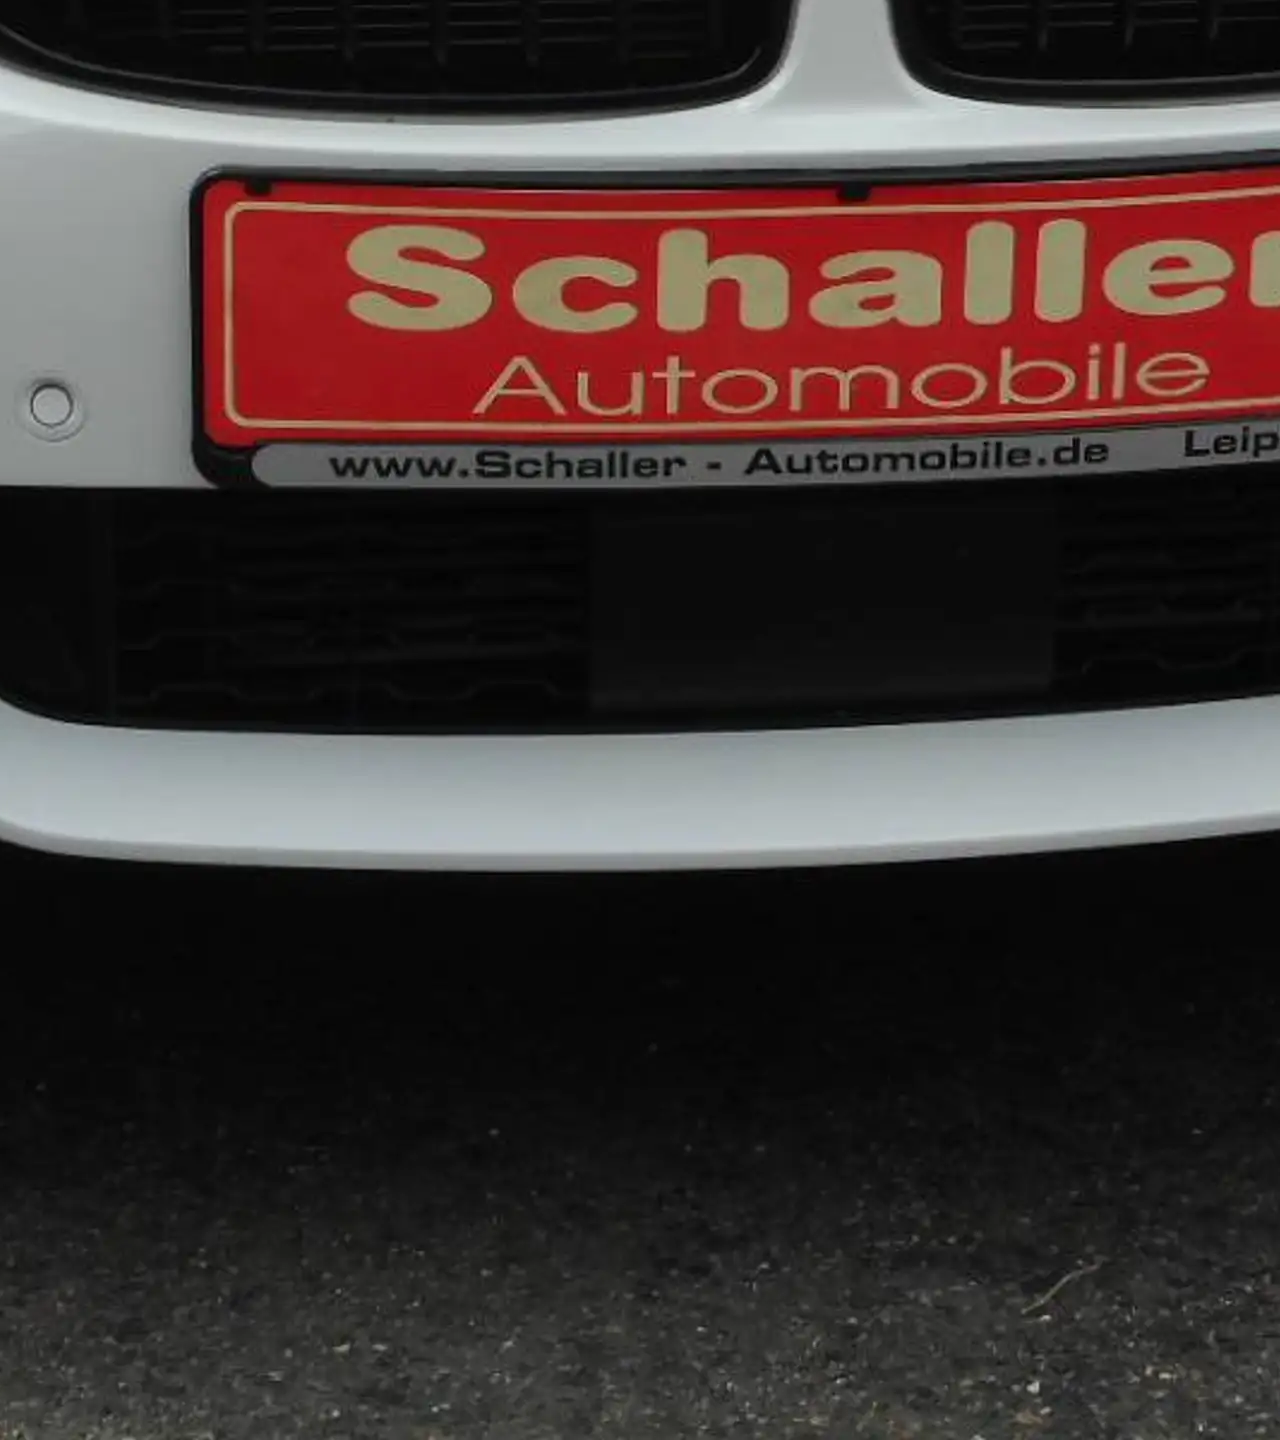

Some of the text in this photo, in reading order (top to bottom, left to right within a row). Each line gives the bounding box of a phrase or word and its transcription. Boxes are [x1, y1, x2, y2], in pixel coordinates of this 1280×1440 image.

[472, 341, 1211, 415] Automobile
[329, 448, 687, 479] www.Schaller
[743, 437, 1110, 476] Automobile.de
